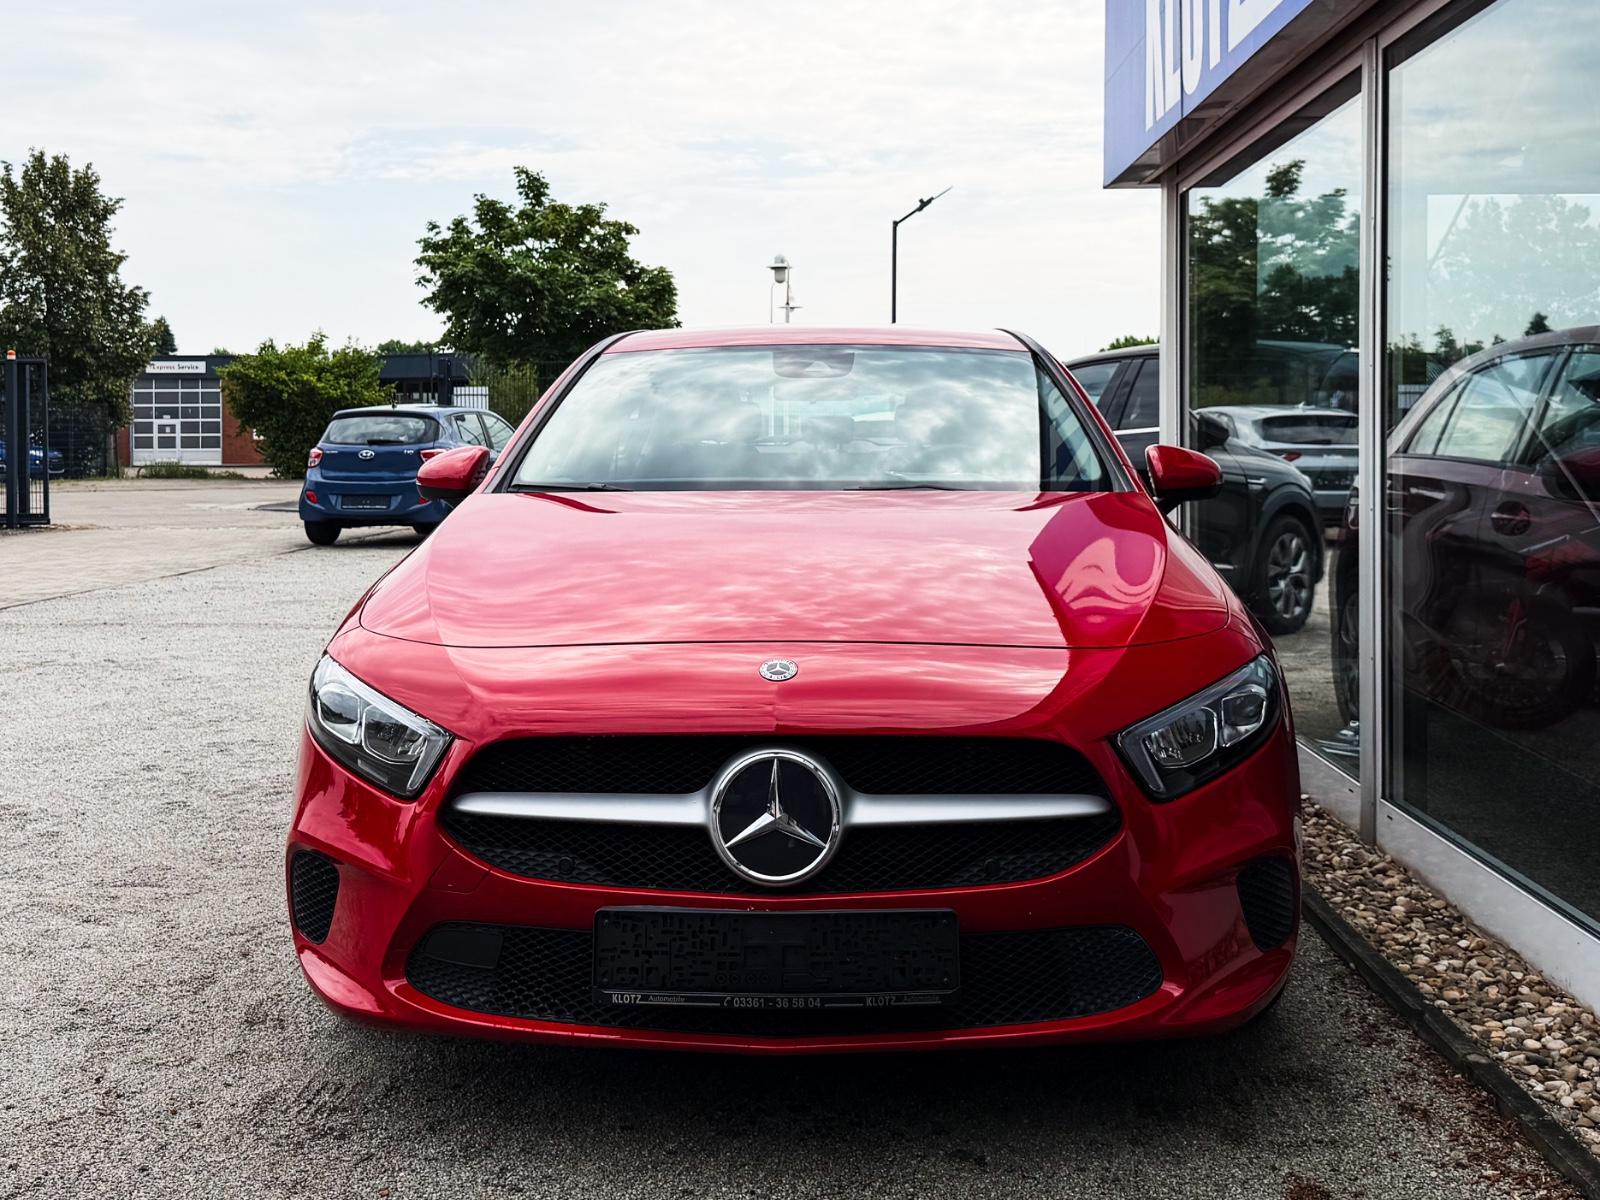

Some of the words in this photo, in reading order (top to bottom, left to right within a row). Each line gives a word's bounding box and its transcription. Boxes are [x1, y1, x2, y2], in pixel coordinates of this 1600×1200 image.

[612, 994, 641, 1004] KLOTZ
[733, 997, 765, 1008] 03361
[776, 998, 790, 1008] 36
[792, 998, 805, 1008] 58
[807, 997, 821, 1008] 04
[866, 996, 896, 1007] KLOTZ
